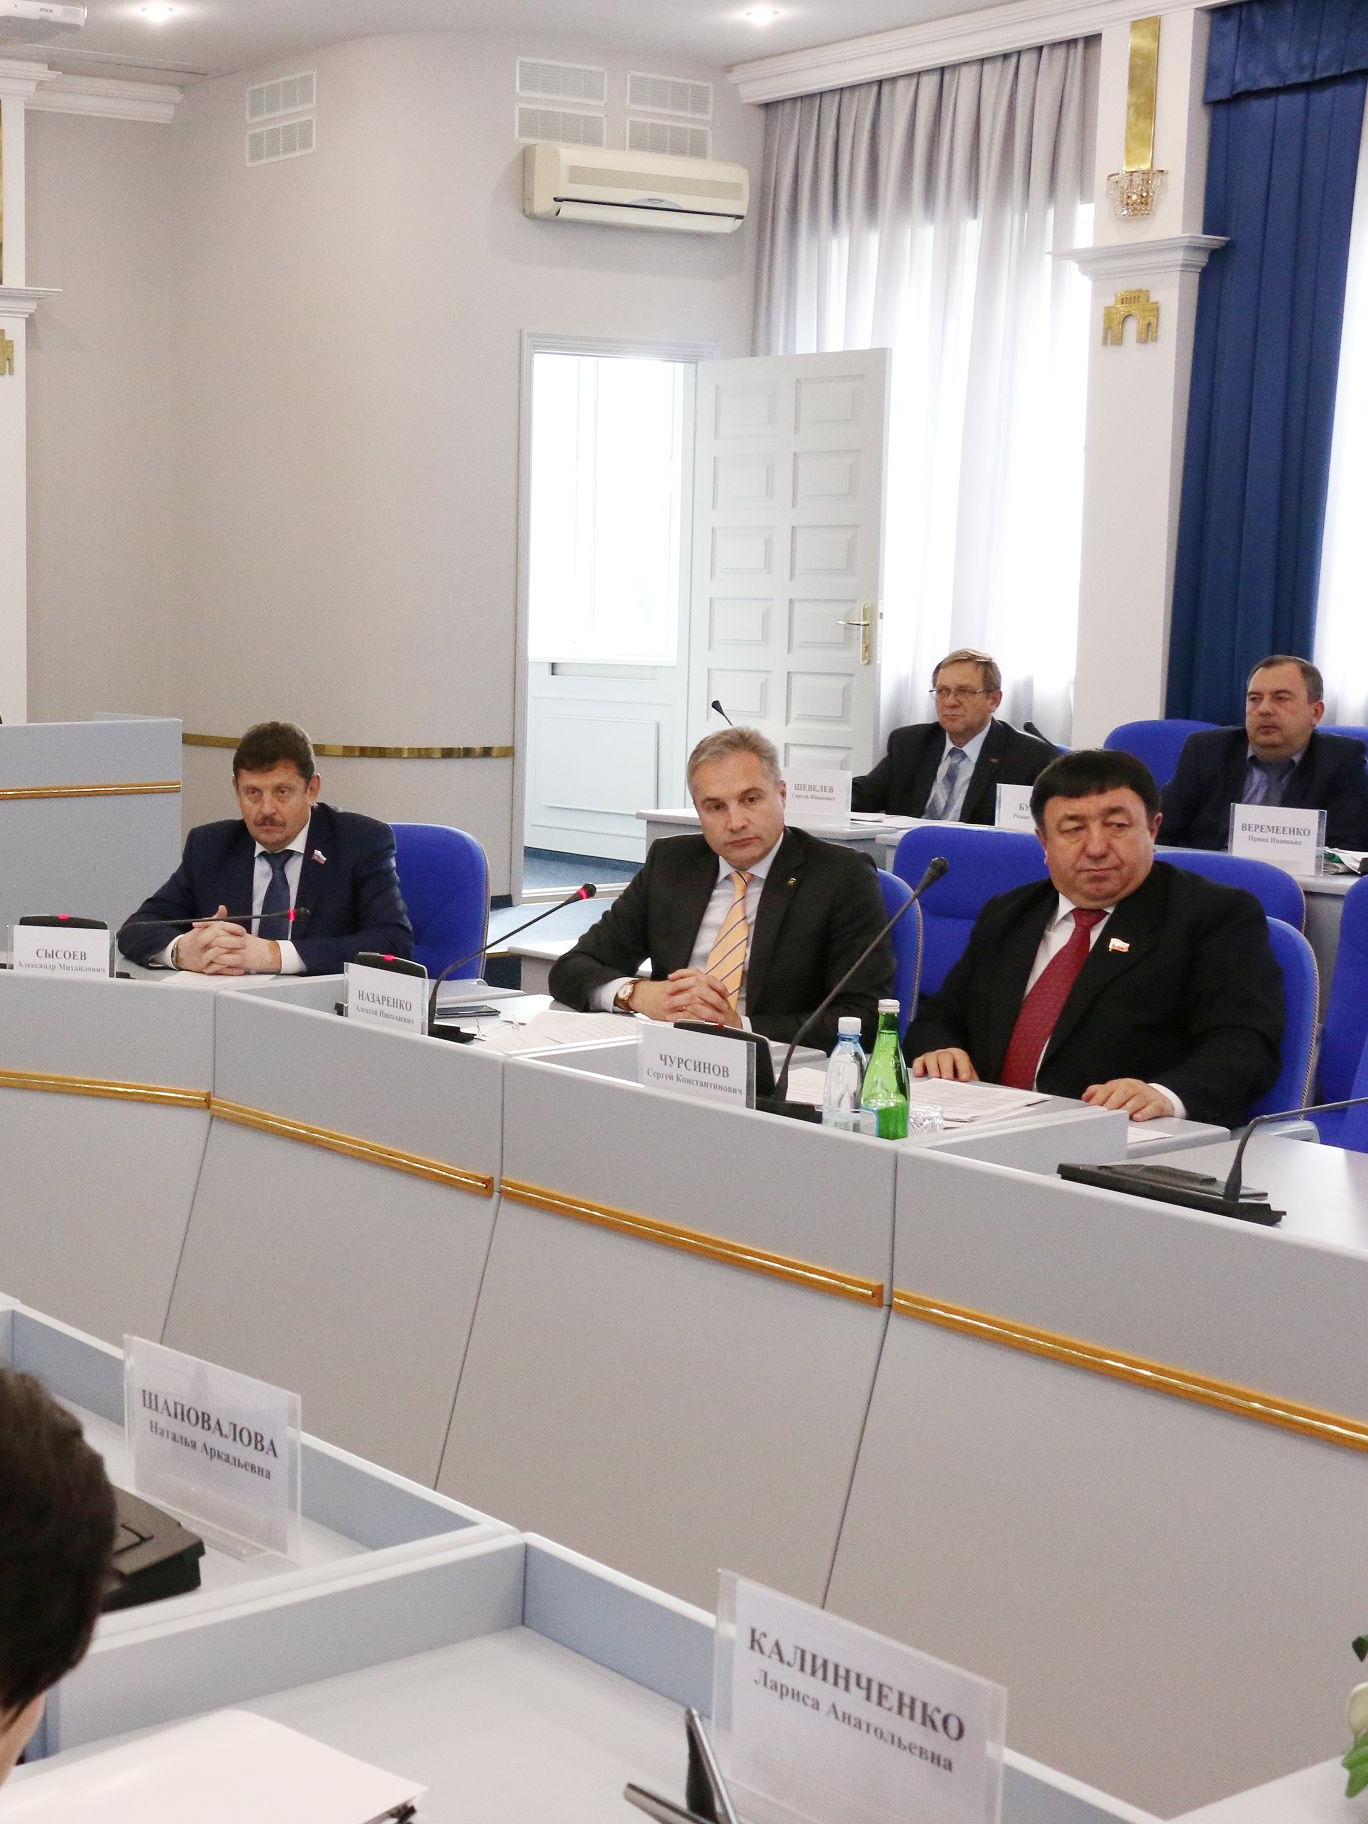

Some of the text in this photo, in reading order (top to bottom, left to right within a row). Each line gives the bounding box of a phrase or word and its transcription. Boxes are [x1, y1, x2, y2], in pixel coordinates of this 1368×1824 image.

[1241, 823, 1311, 837] ВЕРЕМЕЕНКО
[18, 961, 106, 973] Александр Михайлович
[36, 948, 87, 961] СЫСОЕВ
[356, 1004, 378, 1016] Алексей
[358, 989, 412, 1011] НАЗАРЕНКО
[659, 1053, 730, 1078] ЧУРСИНОВ
[647, 1068, 743, 1095] Сергей Константинович
[142, 1389, 279, 1458] ШАПОВАЛОВА
[150, 1420, 272, 1480] Наталья Аркадьевна
[749, 1627, 966, 1742] КАЛИНЧЕНКО
[754, 1669, 954, 1773] Лариса Анатольевна
